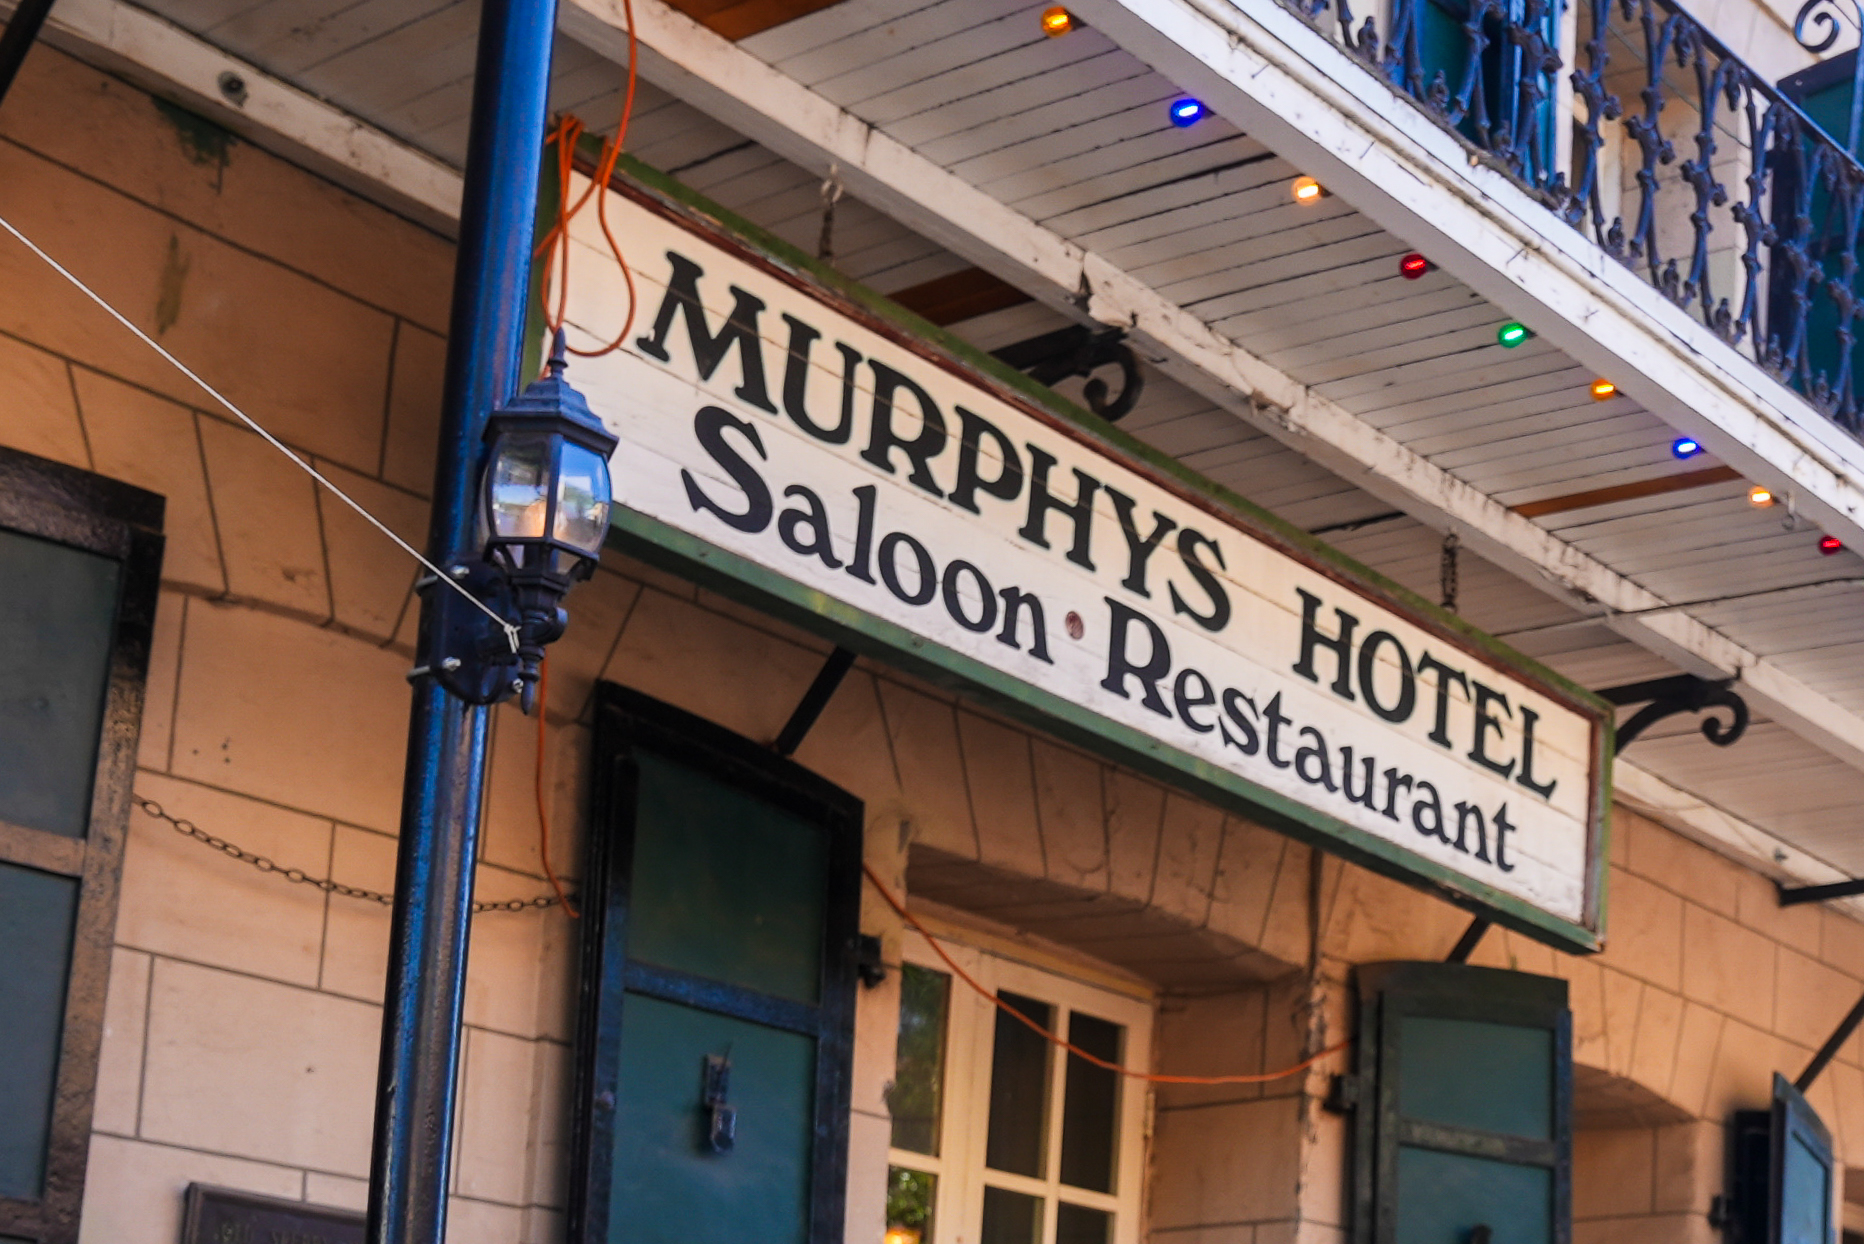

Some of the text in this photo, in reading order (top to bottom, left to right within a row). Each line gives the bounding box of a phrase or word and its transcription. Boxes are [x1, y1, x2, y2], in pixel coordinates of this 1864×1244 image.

[636, 250, 1558, 799] MURPHYS HOTEL
[681, 408, 1517, 875] Saloon Restaurant
